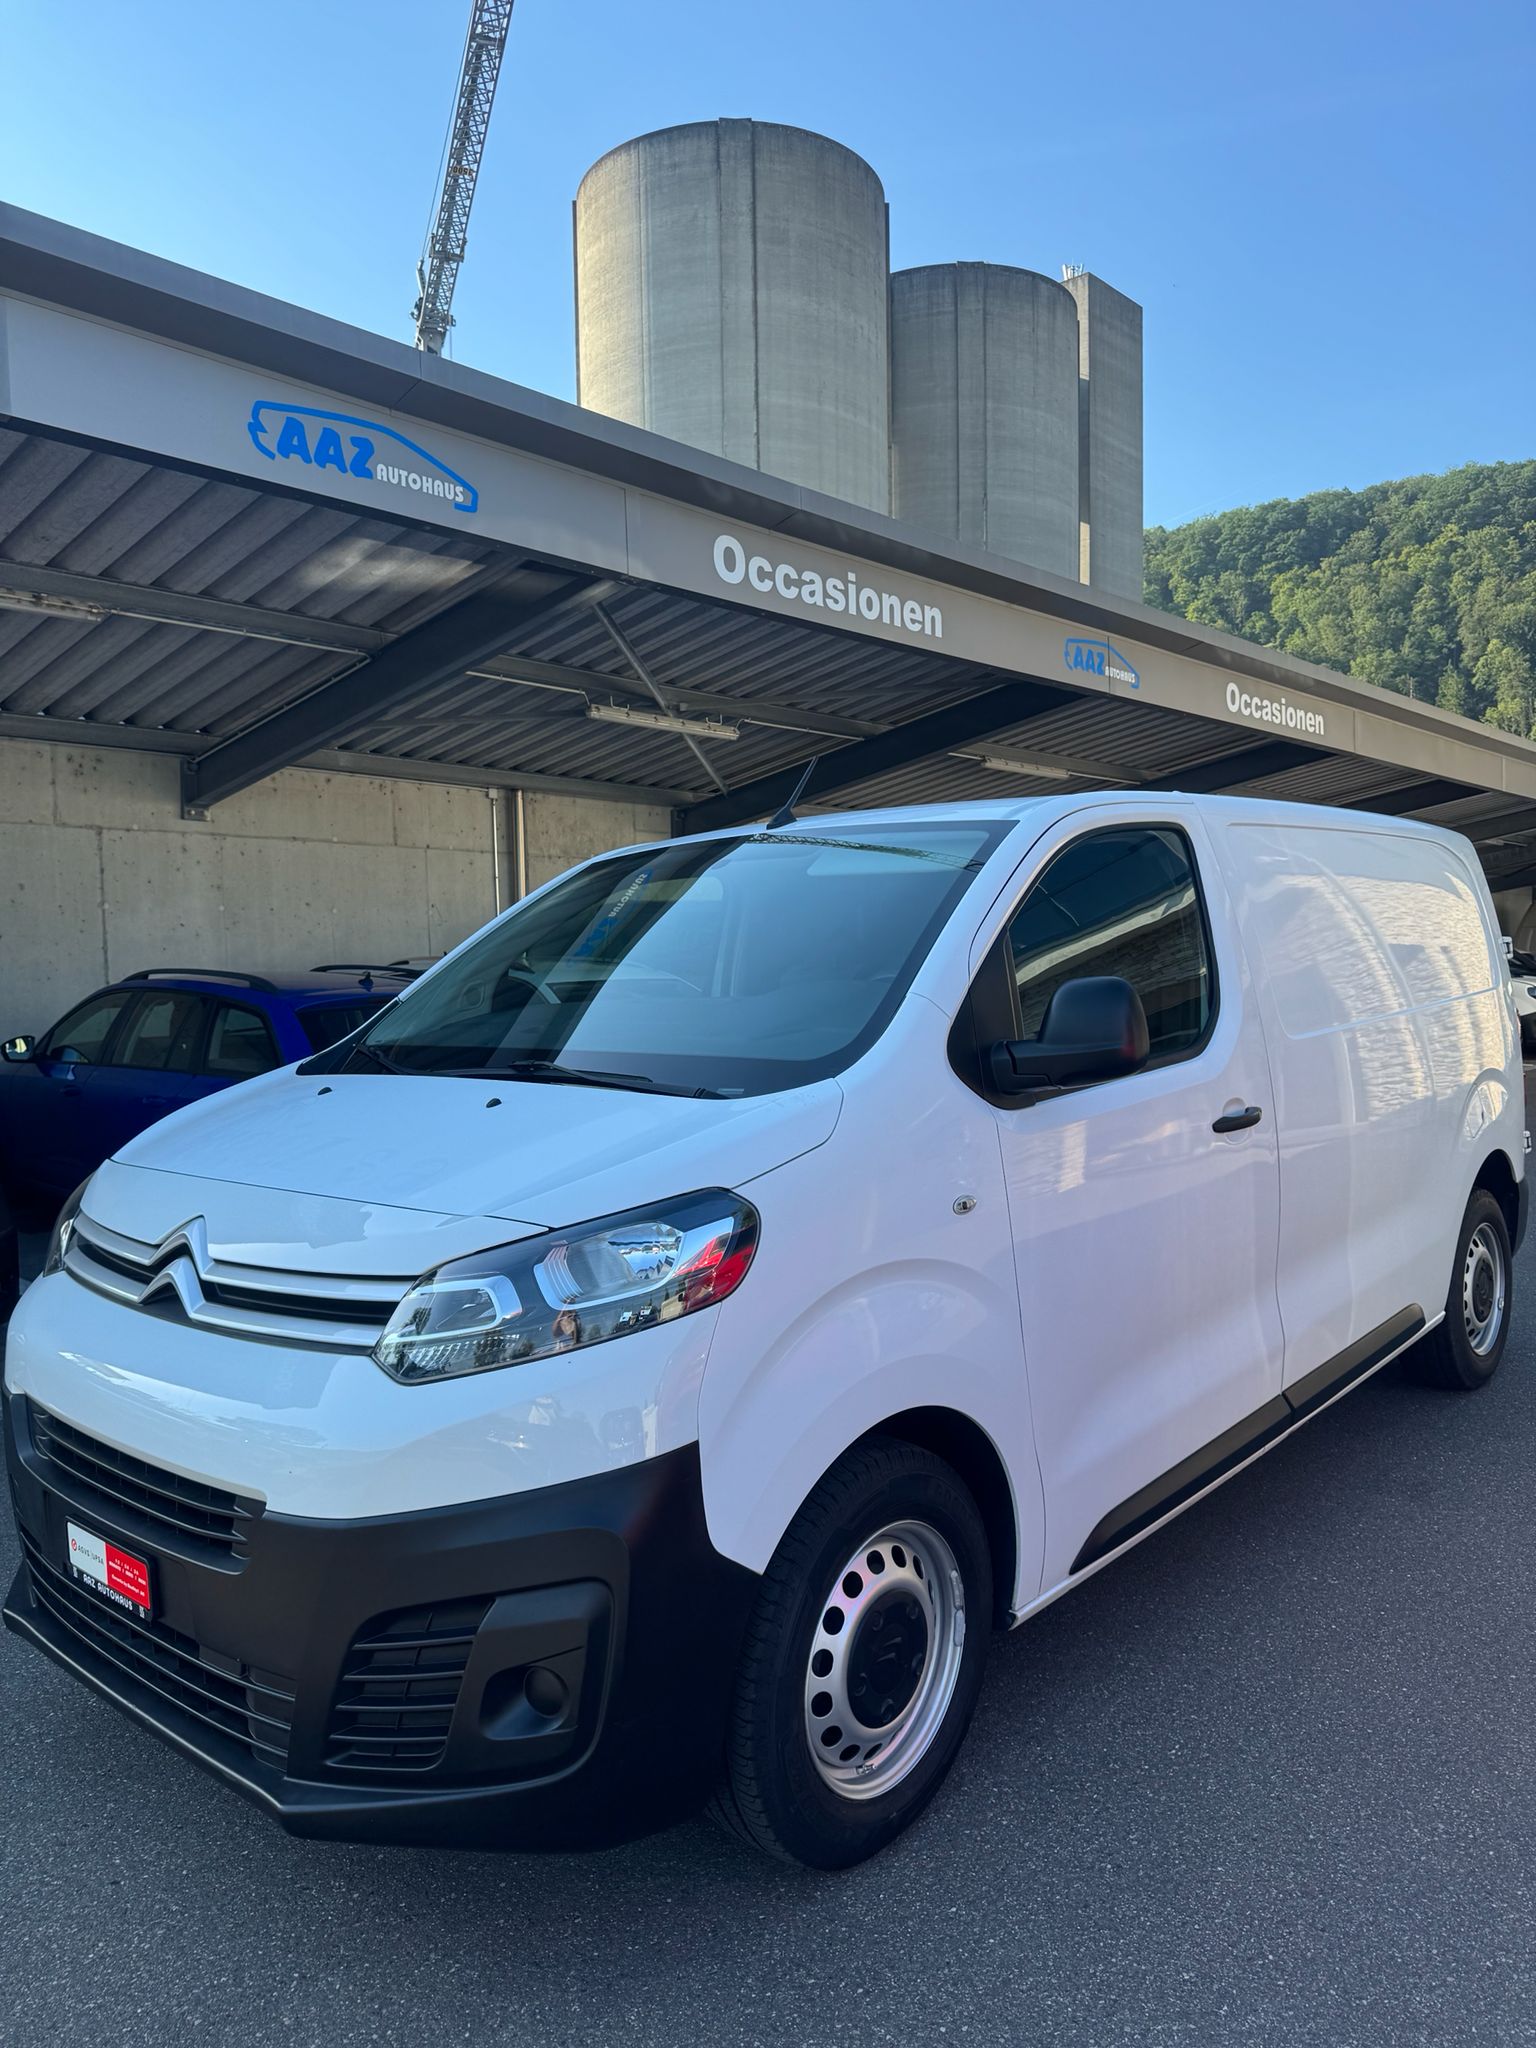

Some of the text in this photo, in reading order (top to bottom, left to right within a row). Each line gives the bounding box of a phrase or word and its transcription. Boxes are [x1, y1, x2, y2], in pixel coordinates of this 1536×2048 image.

[277, 416, 374, 479] AAZ
[376, 463, 465, 503] AUTOHAUS
[713, 534, 943, 638] Occasionen
[1073, 645, 1105, 675] AAZ
[1105, 666, 1136, 683] AUTOHAUS
[1225, 682, 1325, 735] Occasionen
[83, 1574, 96, 1588] AAZ
[97, 1583, 133, 1610] AUTOHAUS
